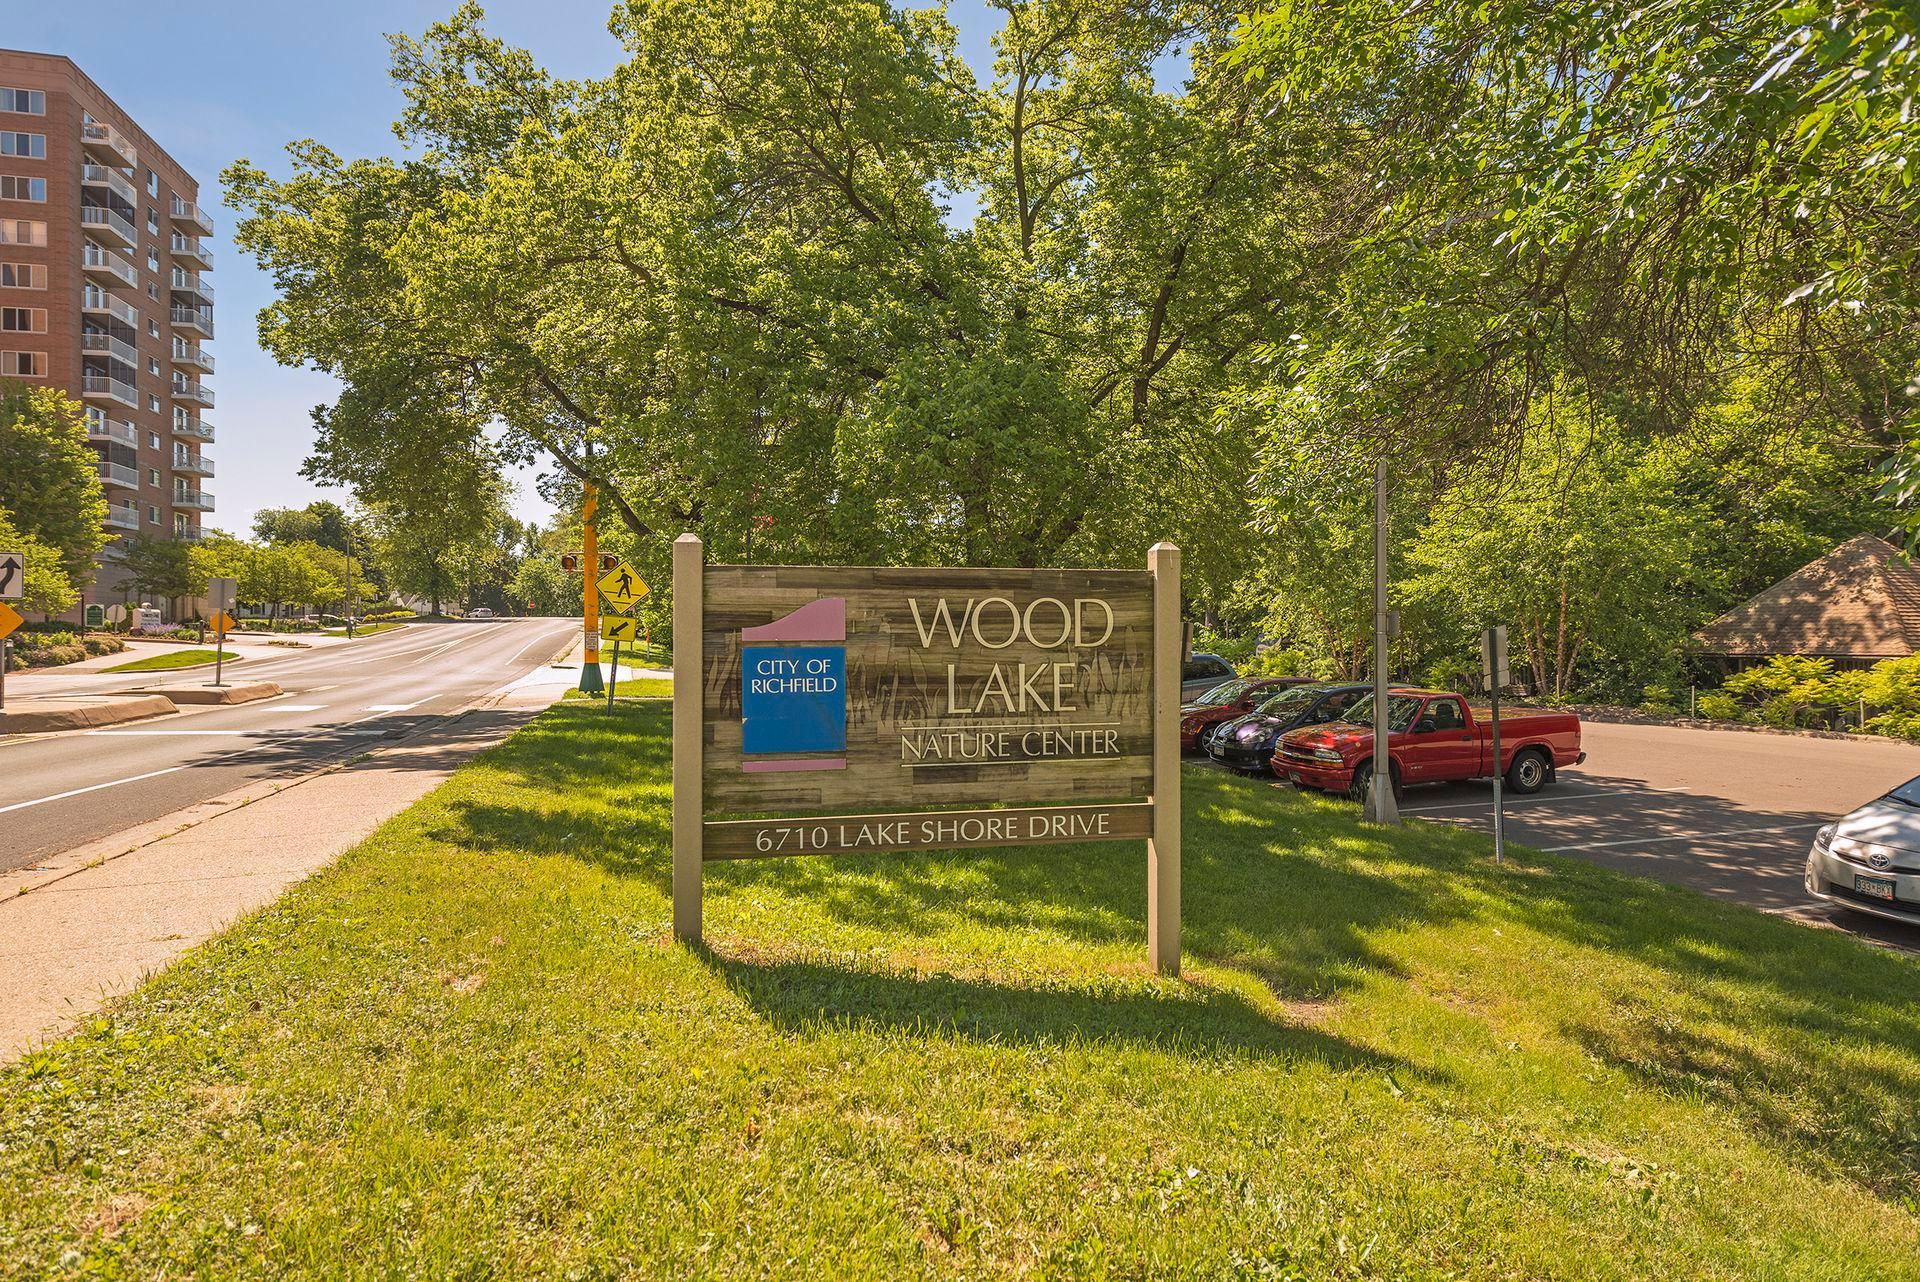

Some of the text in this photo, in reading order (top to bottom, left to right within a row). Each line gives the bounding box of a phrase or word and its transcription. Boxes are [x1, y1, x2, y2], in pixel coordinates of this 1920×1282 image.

[908, 598, 1113, 649] WOOD
[757, 659, 831, 675] CITY OF
[752, 677, 837, 694] RICHFIELD
[947, 663, 1076, 714] LAKE
[901, 730, 1119, 760] NATURE CENTER
[756, 814, 1111, 852] 6710 LAKE SHORE DRIVE
